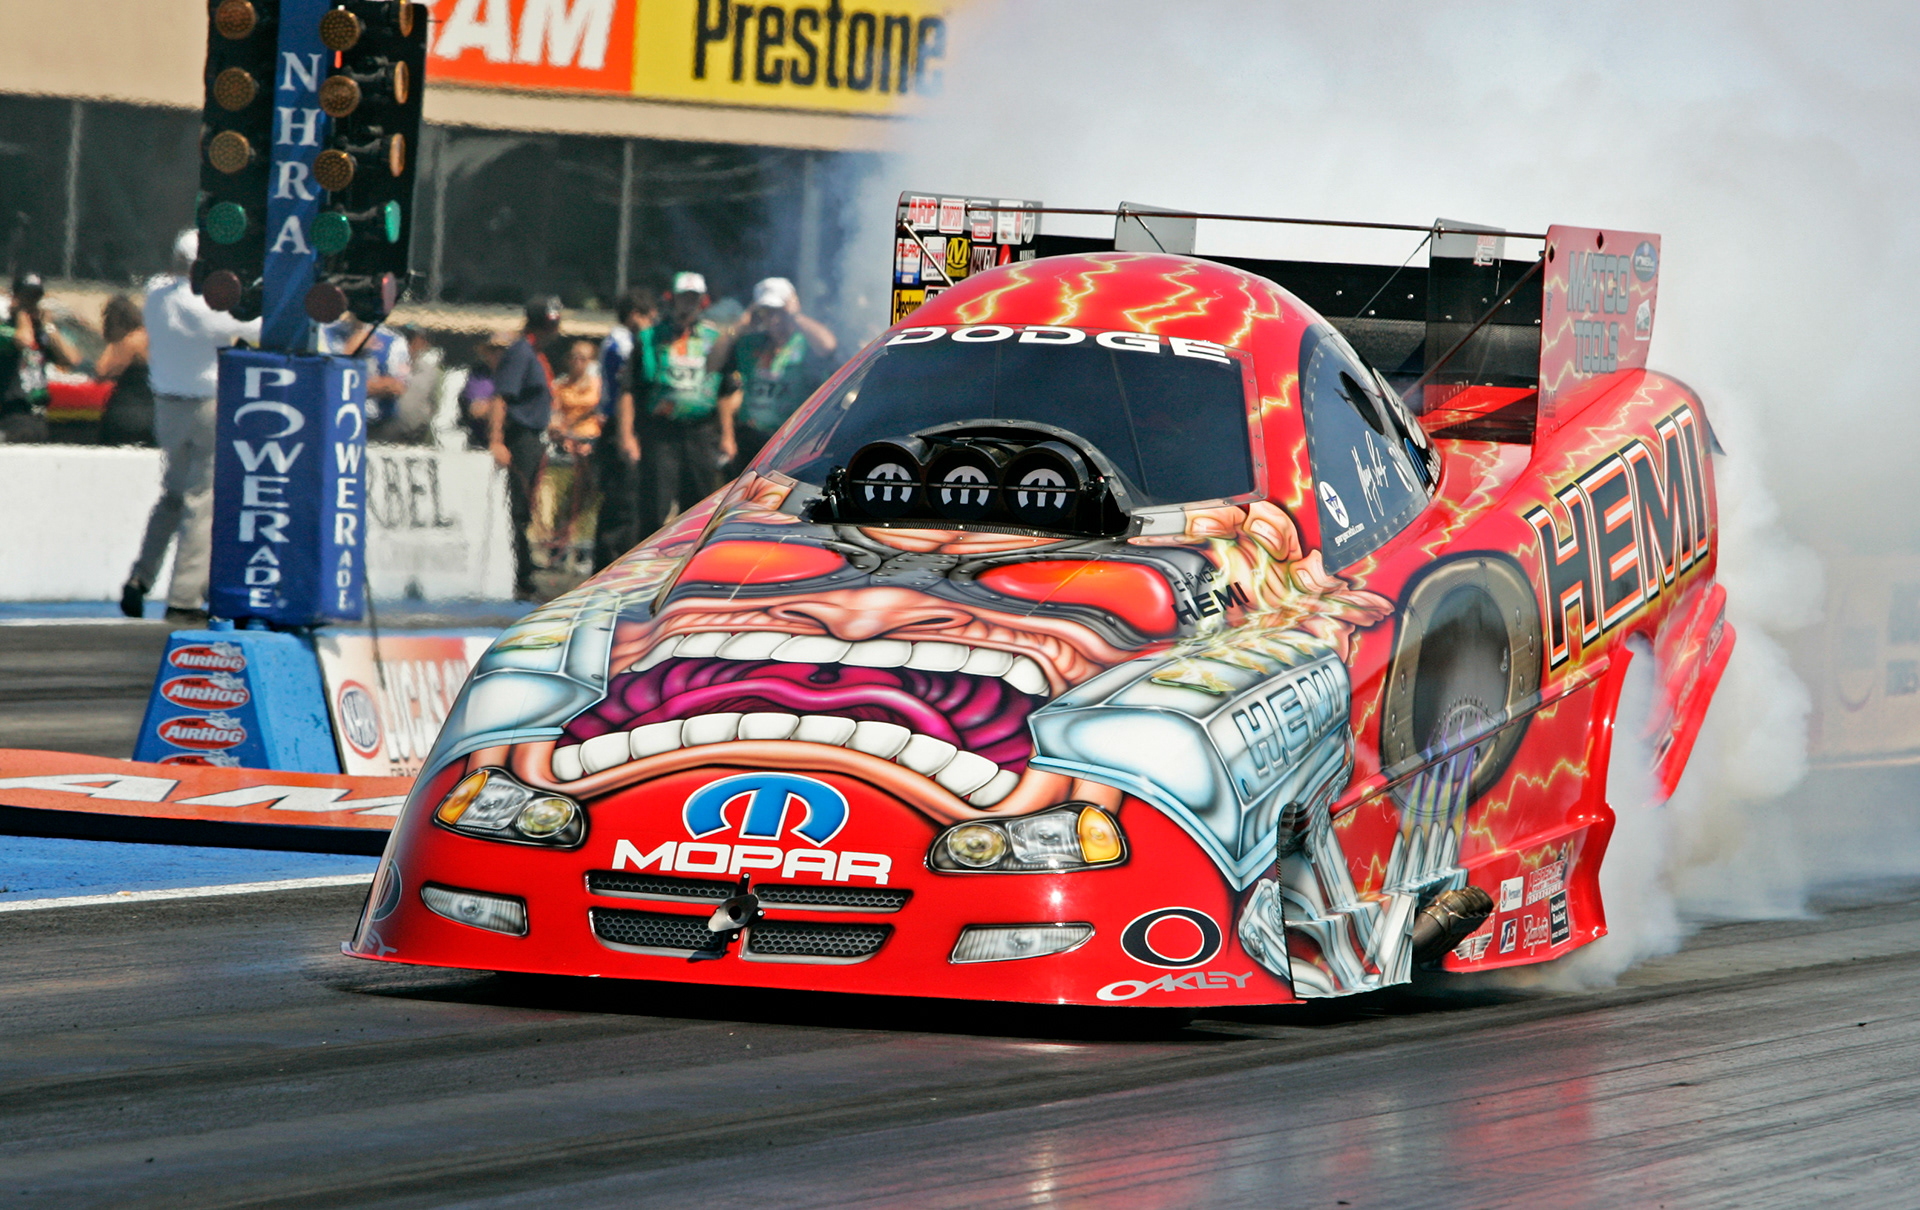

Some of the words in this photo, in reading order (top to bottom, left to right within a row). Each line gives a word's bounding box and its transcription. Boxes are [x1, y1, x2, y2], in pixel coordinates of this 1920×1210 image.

[692, 0, 947, 96] Prestone
[270, 52, 322, 255] NHRA
[1567, 251, 1631, 314] MATCO
[885, 325, 1231, 364] DODGE
[1574, 319, 1619, 374] TOOLS
[233, 366, 305, 608] POWERADE
[334, 368, 362, 610] POWERADE
[1522, 403, 1710, 672] HEMI
[1171, 581, 1249, 626] HEMI
[1231, 663, 1342, 777] HEMI
[611, 838, 892, 885] MOPAR
[1096, 971, 1253, 1001] OAKLEY
